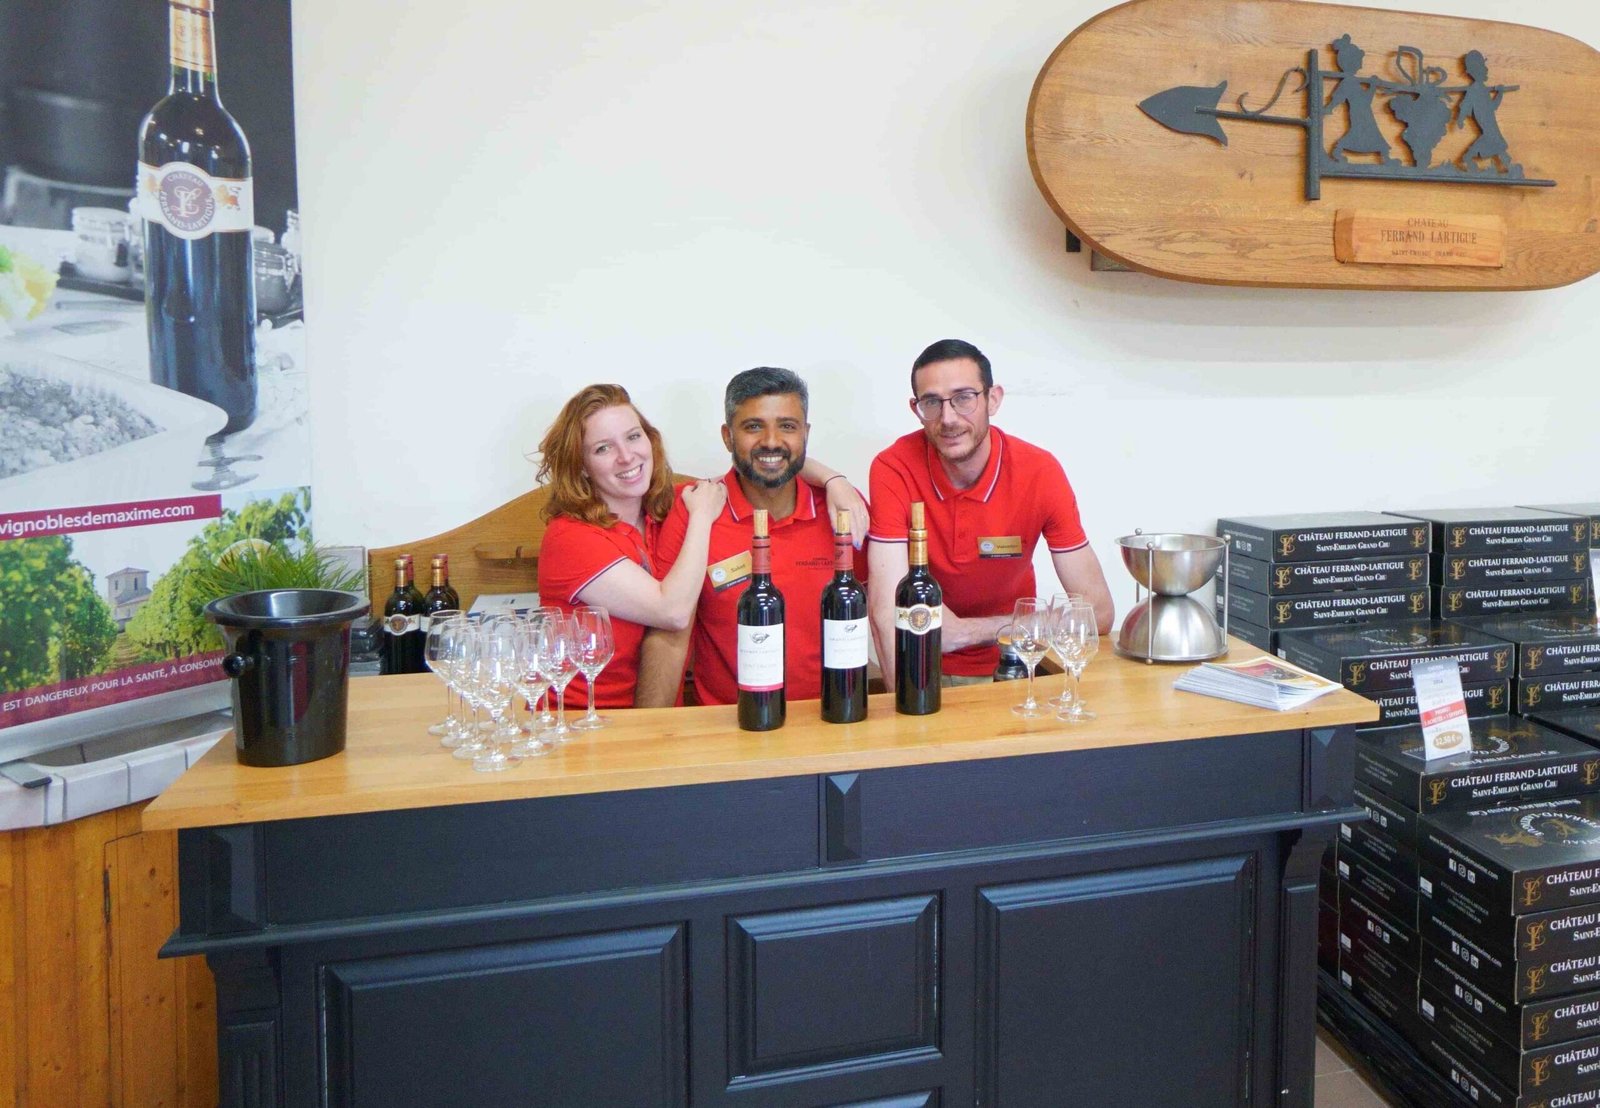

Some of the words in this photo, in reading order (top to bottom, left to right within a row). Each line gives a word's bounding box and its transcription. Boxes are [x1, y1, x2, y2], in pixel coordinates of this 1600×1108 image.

[1381, 230, 1424, 243] FERRAND
[1431, 232, 1477, 244] LARTIGUE
[1298, 530, 1333, 542] CHÂTEAU
[1335, 528, 1408, 541] FERRAND-LARTIGUE
[1469, 524, 1502, 536] CHÂTEAU
[1503, 524, 1569, 534] FERRAND-LARTIGUE
[1294, 562, 1330, 576] CHÂTEAU
[1332, 561, 1404, 573] FERRAND-LARTIGUE
[1468, 556, 1501, 568] CHÂTEAU
[1502, 555, 1568, 565] FERRAND-LARTIGUE
[1466, 588, 1499, 600] CHÂTEAU
[1500, 586, 1566, 597] FERRAND-LARTIGUE
[1295, 597, 1330, 610] CHÂTEAU
[1332, 594, 1405, 607] FERRAND-LARTIGUE
[1546, 645, 1581, 656] CHÂTEAU
[1370, 658, 1408, 670] CHÂTEAU
[3, 700, 22, 712] EST
[25, 686, 88, 708] DANGEREUX
[92, 678, 118, 692] POUR
[121, 675, 133, 686] LA
[1545, 681, 1579, 692] CHÂTEAU
[1451, 775, 1492, 788] CHÂTEAU
[1495, 764, 1578, 782] FERRAND-LARTIGUE
[1546, 869, 1592, 885] CHÂTEAU
[1550, 915, 1595, 930] CHÂTEAU
[1550, 956, 1595, 973] CHÂTEAU
[1555, 1001, 1599, 1019] CHÂTEAU
[1555, 1046, 1599, 1065] CHÂTEAU
[1550, 1090, 1596, 1108] CHÂTEAU
